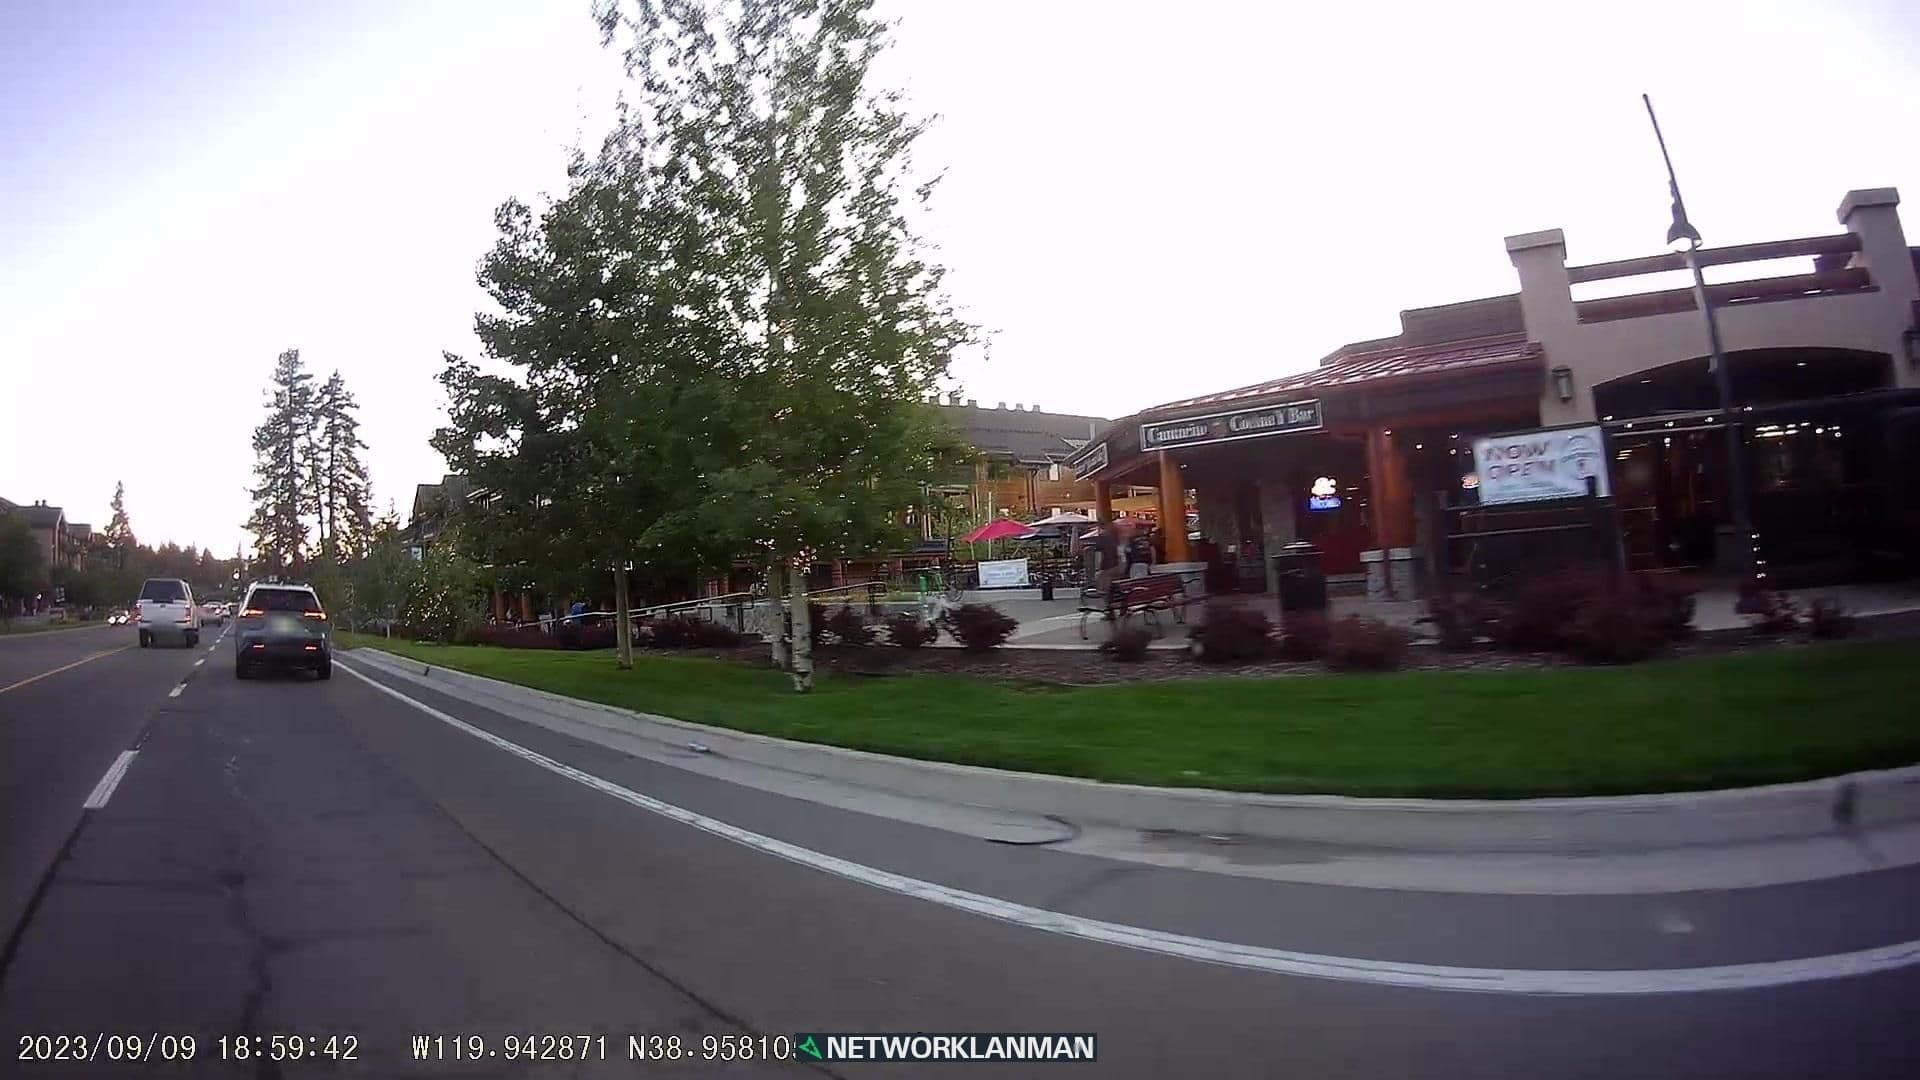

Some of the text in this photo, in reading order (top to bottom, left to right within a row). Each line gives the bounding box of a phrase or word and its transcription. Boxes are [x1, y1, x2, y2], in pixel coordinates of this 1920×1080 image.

[1287, 407, 1314, 423] Bar
[1486, 441, 1549, 461] NOW
[1488, 460, 1556, 479] OPEN
